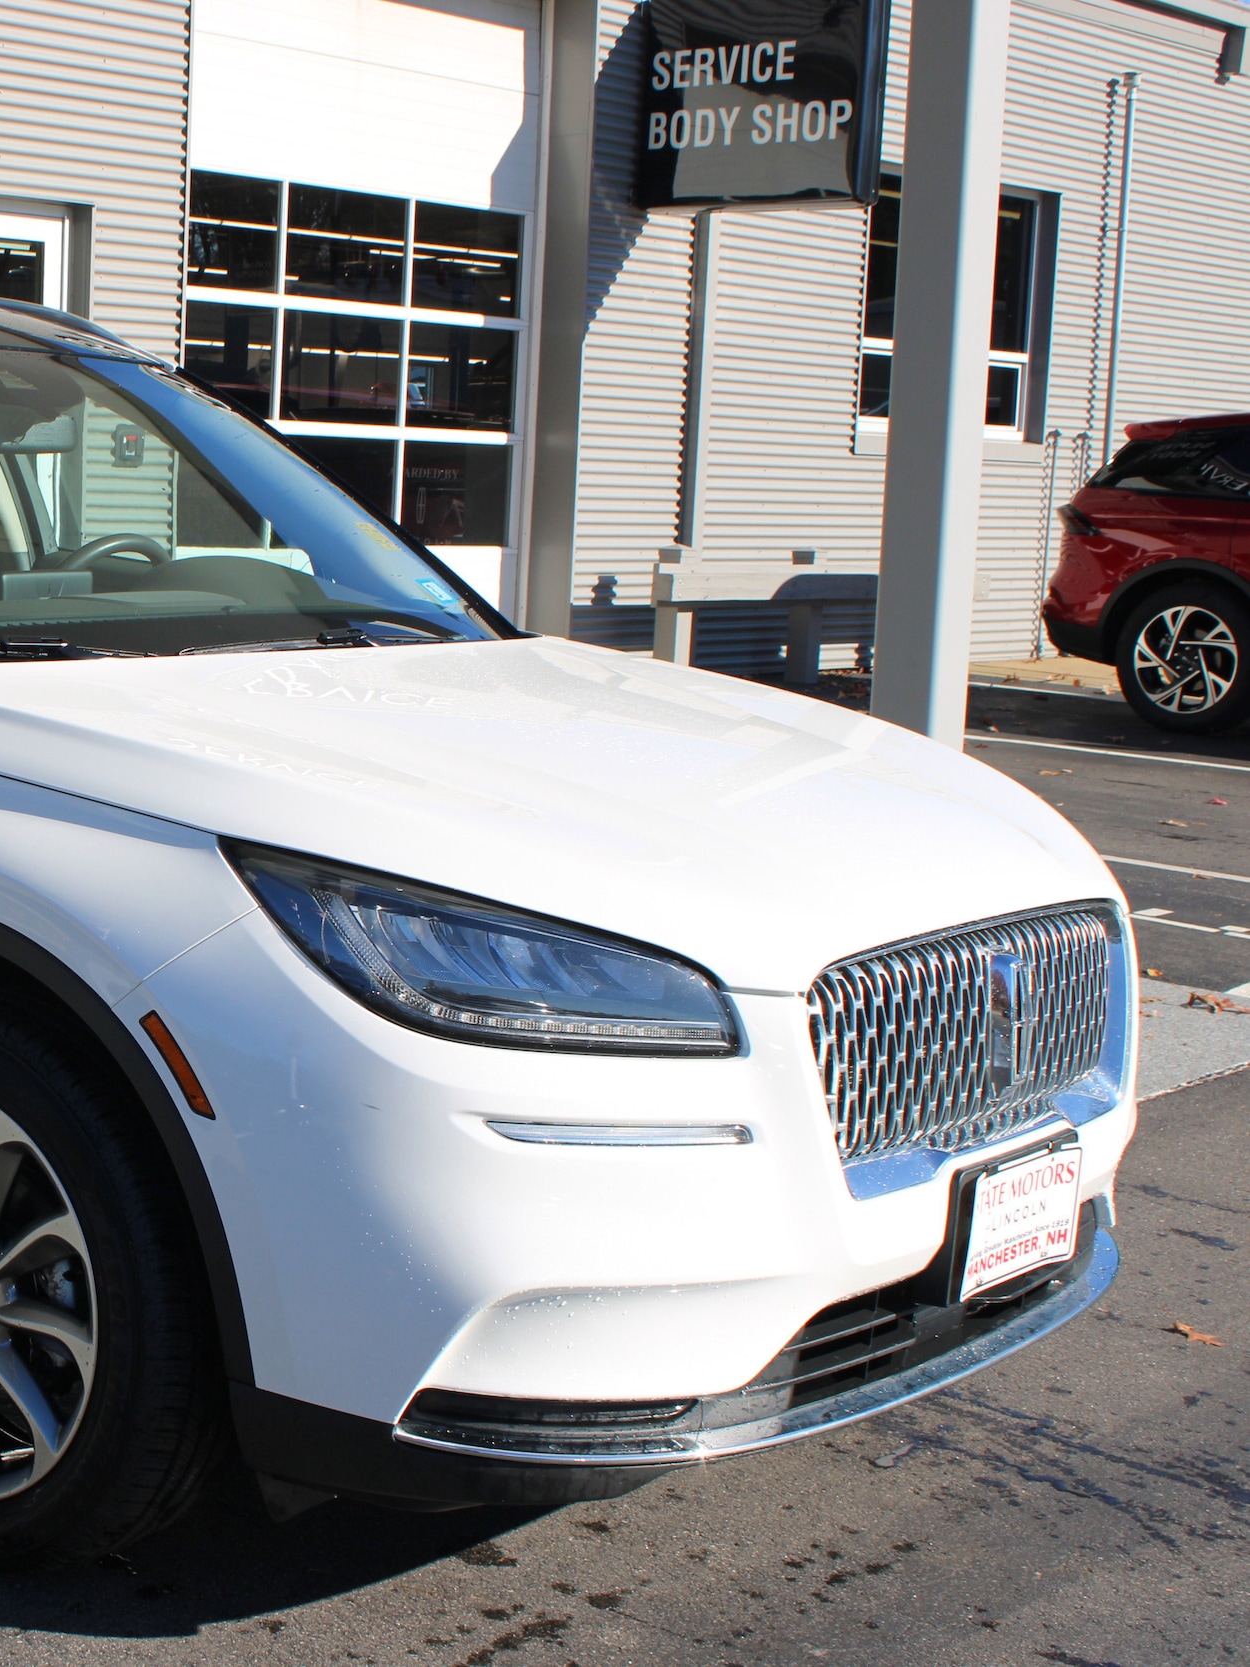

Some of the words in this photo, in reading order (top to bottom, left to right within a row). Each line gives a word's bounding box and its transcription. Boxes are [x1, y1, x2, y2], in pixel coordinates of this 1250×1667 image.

[651, 40, 797, 91] SERVICE
[648, 106, 741, 150] BODY
[751, 99, 853, 145] SHOP
[388, 466, 441, 480] AARDED
[444, 468, 459, 480] BY
[1010, 1161, 1076, 1199] MOTORS
[991, 1200, 1047, 1232] LINCOLN
[1051, 1218, 1070, 1229] 1919
[1046, 1228, 1069, 1246] NH
